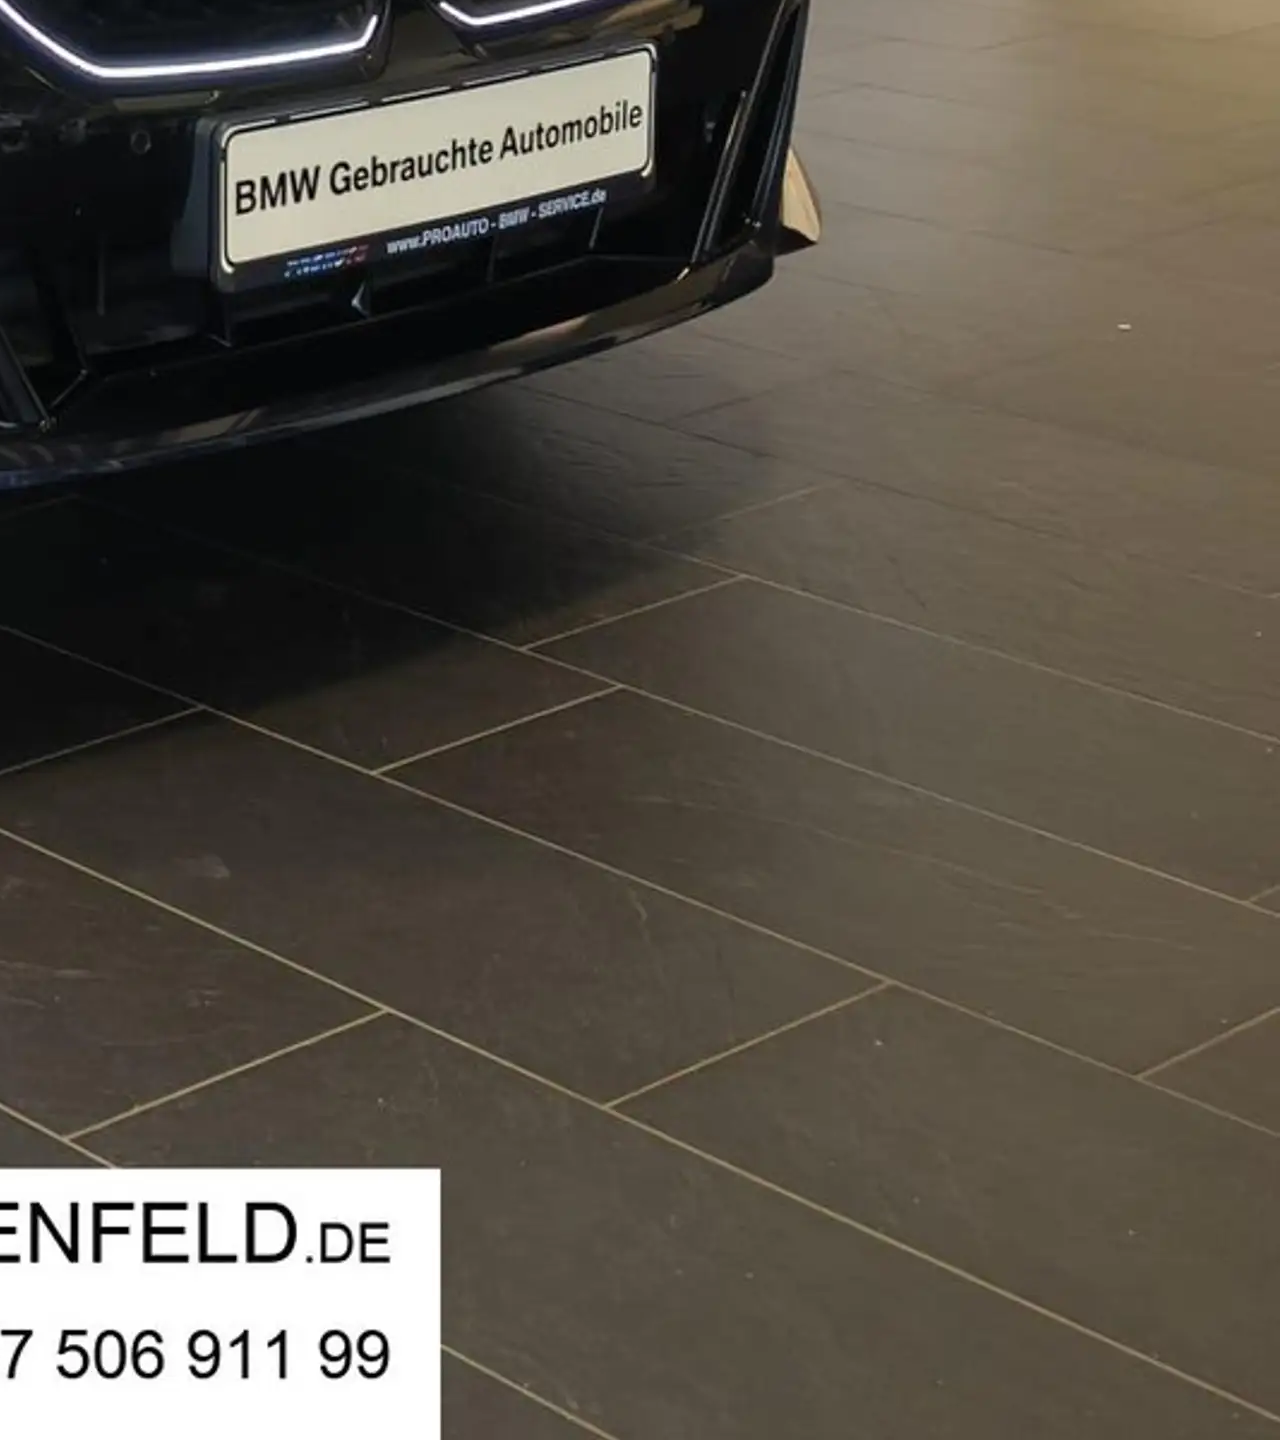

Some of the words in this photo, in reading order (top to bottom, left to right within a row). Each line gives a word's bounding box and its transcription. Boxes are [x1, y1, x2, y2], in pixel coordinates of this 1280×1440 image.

[235, 165, 321, 216] BMW
[329, 136, 494, 196] Gebrauchte
[500, 99, 643, 160] Automobile
